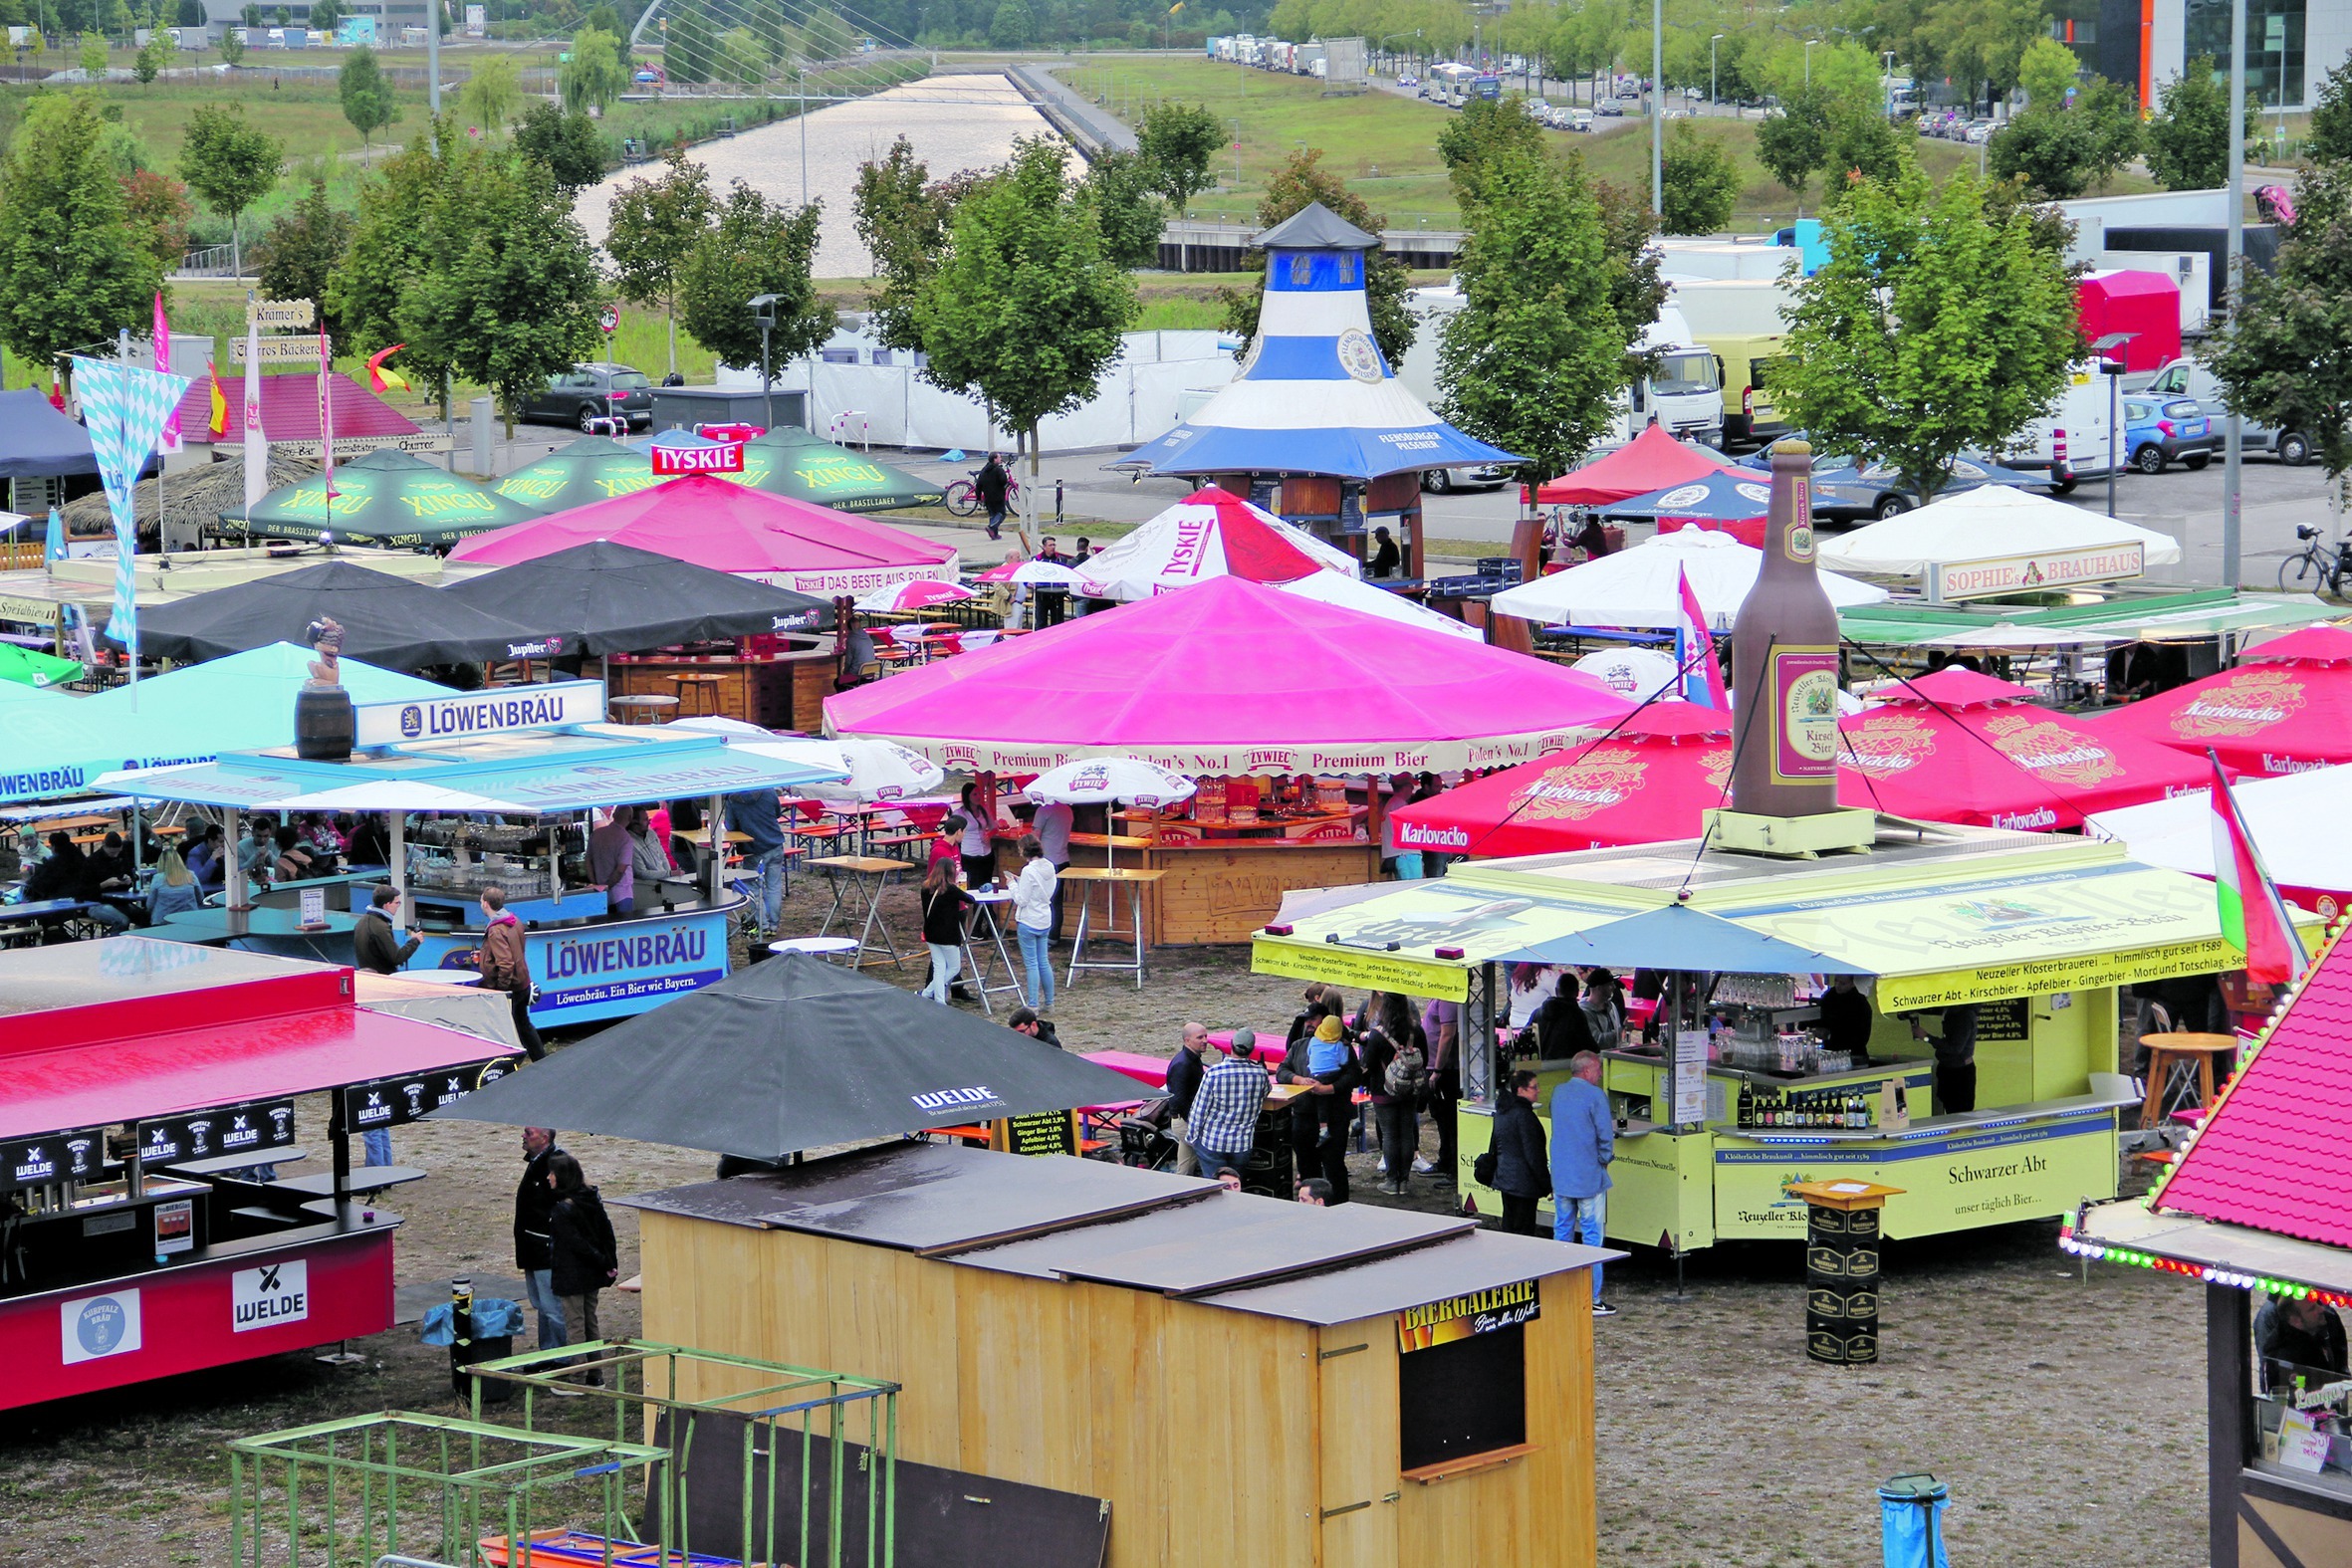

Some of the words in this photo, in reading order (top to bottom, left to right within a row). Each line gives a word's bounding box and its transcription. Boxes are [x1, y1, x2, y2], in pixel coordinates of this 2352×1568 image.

[256, 308, 304, 321] Krämer's
[280, 342, 321, 356] Bäckere
[398, 440, 435, 451] Churros
[1378, 431, 1443, 443] FLENSBURGER
[1395, 441, 1440, 451] PILSENER
[656, 445, 738, 470] TYSKIE
[795, 464, 886, 489] XINGU
[495, 478, 570, 499] XINGU
[279, 488, 373, 515] XINGU
[399, 491, 496, 517] XINGU
[832, 501, 846, 510] DER
[849, 497, 896, 509] BRASILIANER
[267, 524, 281, 534] DER
[441, 531, 456, 541] DER
[389, 533, 422, 547] XINGU
[1161, 520, 1203, 575] TYSKIE
[1946, 566, 2020, 592] SOPHIE's
[2047, 552, 2141, 580] BRAUHAUS
[797, 577, 825, 591] TYSKIE
[827, 575, 849, 590] DAS
[851, 573, 883, 589] BESTE
[923, 589, 956, 602] TYSKIE
[772, 614, 809, 629] Jupiler
[508, 642, 547, 657] Jupiler
[429, 693, 564, 735] LÖWENBRÄU
[2185, 701, 2284, 722] Karlovačko
[1468, 745, 1503, 764] Polen's
[1507, 742, 1529, 759] No.1
[1810, 743, 1832, 754] Bier
[993, 751, 1052, 768] Premium
[1194, 754, 1230, 770] No.1
[1250, 749, 1292, 765] ŻYWIEC
[1311, 752, 1385, 769] Premium
[1394, 751, 1429, 768] Bier
[2013, 747, 2107, 770] Karlovačko
[1525, 780, 1620, 804] Karlovačko
[1400, 821, 1469, 847] Karlovačko
[546, 927, 706, 981] LÖWENBRÄU
[1976, 967, 2021, 982] Neuzeller
[2022, 956, 2099, 976] Klosterbrauerei
[2113, 948, 2161, 965] himmlisch
[2162, 946, 2179, 961] gut
[2181, 943, 2199, 956] seit
[2201, 940, 2223, 953] 1589
[1297, 953, 1321, 964] Neuzeller
[1366, 963, 1381, 973] Jedes
[1381, 964, 1392, 974] Bier
[1255, 956, 1281, 968] Schwarzer
[1281, 959, 1290, 969] Abt
[1293, 962, 1318, 973] Kirschbier
[1320, 966, 1343, 977] Apfelbier
[1346, 969, 1372, 981] Gingerbier
[1376, 974, 1390, 984] Mord
[1390, 976, 1399, 985] und
[1399, 977, 1424, 990] Totschlag
[1454, 983, 1465, 994] Bier
[1892, 990, 1942, 1008] Schwarzer
[1944, 988, 1962, 1002] Abt
[1969, 982, 2019, 999] Kirschbier
[2026, 976, 2072, 993] Apfelbier
[2078, 970, 2126, 988] Gingerbier
[2133, 965, 2159, 979] Mord
[2159, 962, 2178, 975] und
[2179, 956, 2225, 975] Totschlag
[556, 988, 608, 1006] Löwenbräu.
[609, 985, 626, 998] Ein
[627, 982, 646, 995] Bier
[647, 981, 663, 992] wie
[664, 976, 697, 992] Bayern.
[911, 1085, 999, 1110] WELDE
[358, 1105, 391, 1120] WELDE
[927, 1104, 979, 1117] Braumanufaktur
[979, 1101, 991, 1110] seit
[1012, 1119, 1042, 1128] Schwarzer
[223, 1128, 258, 1144] WELDE
[1017, 1128, 1036, 1137] Ginger
[1021, 1135, 1047, 1145] Apfelbier
[140, 1142, 176, 1158] WELDE
[1020, 1144, 1048, 1153] Kirschbier
[1833, 1153, 1844, 1162] gut
[16, 1161, 53, 1177] WELDE
[1949, 1162, 2018, 1185] Schwarzer
[2020, 1155, 2047, 1173] Abt
[155, 1202, 191, 1214] ProBIERGlas
[1955, 1203, 1980, 1215] unser
[1981, 1196, 2011, 1213] täglich
[2013, 1193, 2042, 1206] Bier...
[1738, 1211, 1785, 1227] Neuzeller
[83, 1304, 119, 1320] KURPFALZ
[236, 1292, 305, 1324] WELDE
[1404, 1279, 1534, 1331] BIERGALERIE
[1514, 1302, 1541, 1323] Welt
[91, 1313, 111, 1325] BRÄU
